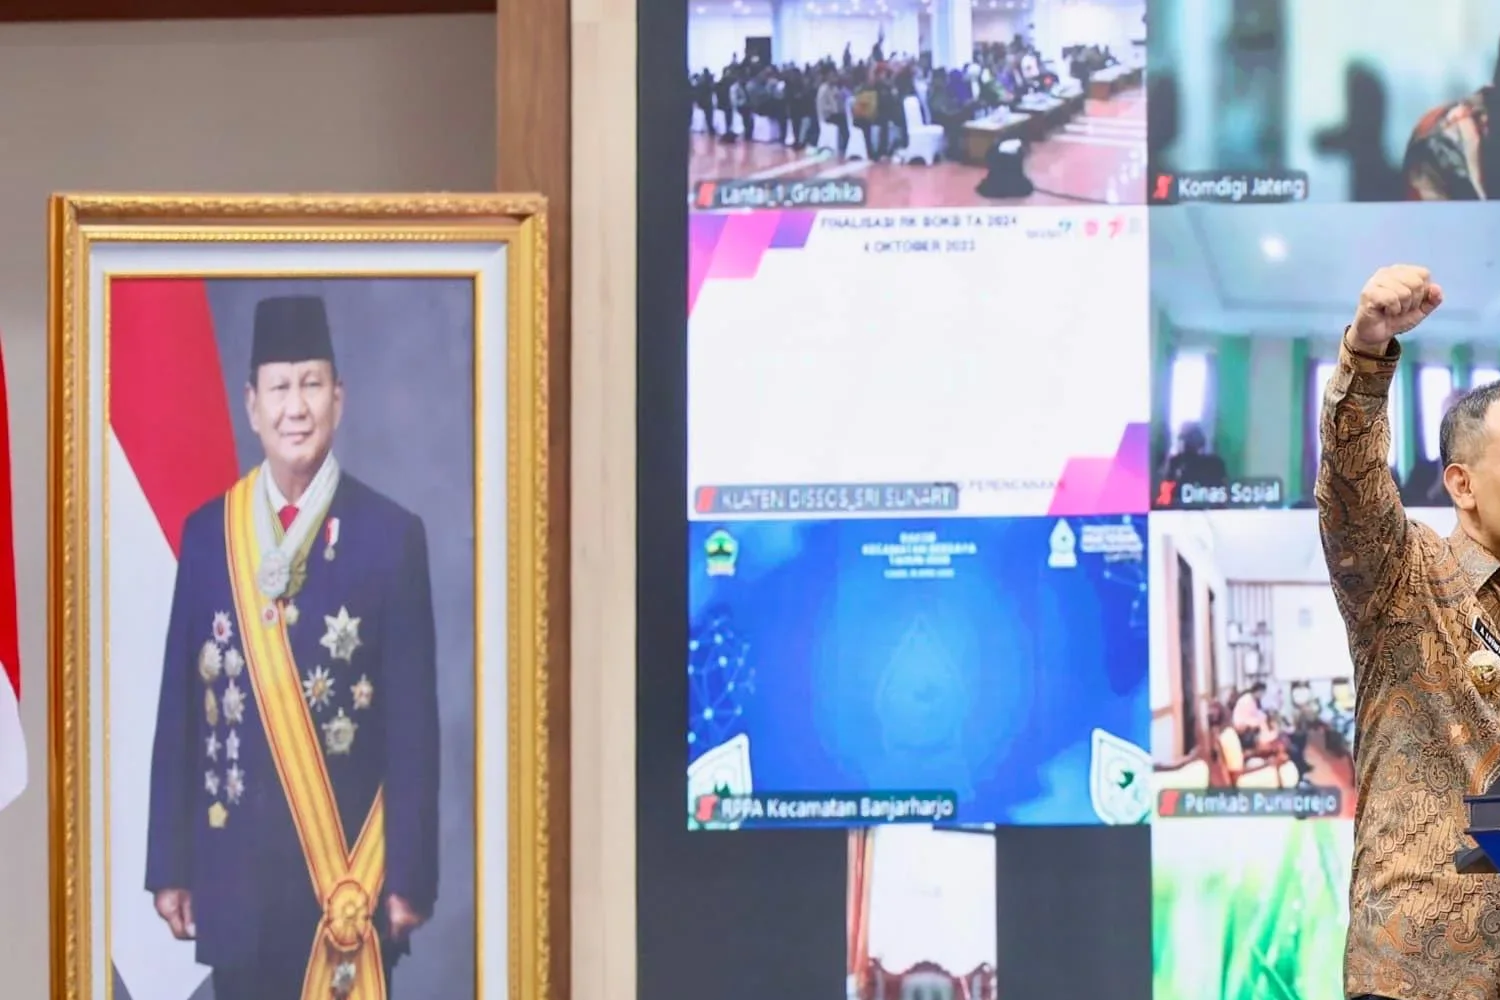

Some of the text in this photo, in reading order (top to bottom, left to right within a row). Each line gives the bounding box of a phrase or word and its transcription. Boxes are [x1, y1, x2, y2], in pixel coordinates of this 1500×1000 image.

[1178, 175, 1306, 201] Komdigi Jateng
[874, 240, 940, 252] OKTOBER
[722, 489, 784, 510] KLATEN
[1181, 481, 1280, 504] Dinas Sosial
[767, 797, 857, 819] Kecamatan
[860, 796, 954, 821] Banjarharjo
[1185, 792, 1250, 813] Pemkab
